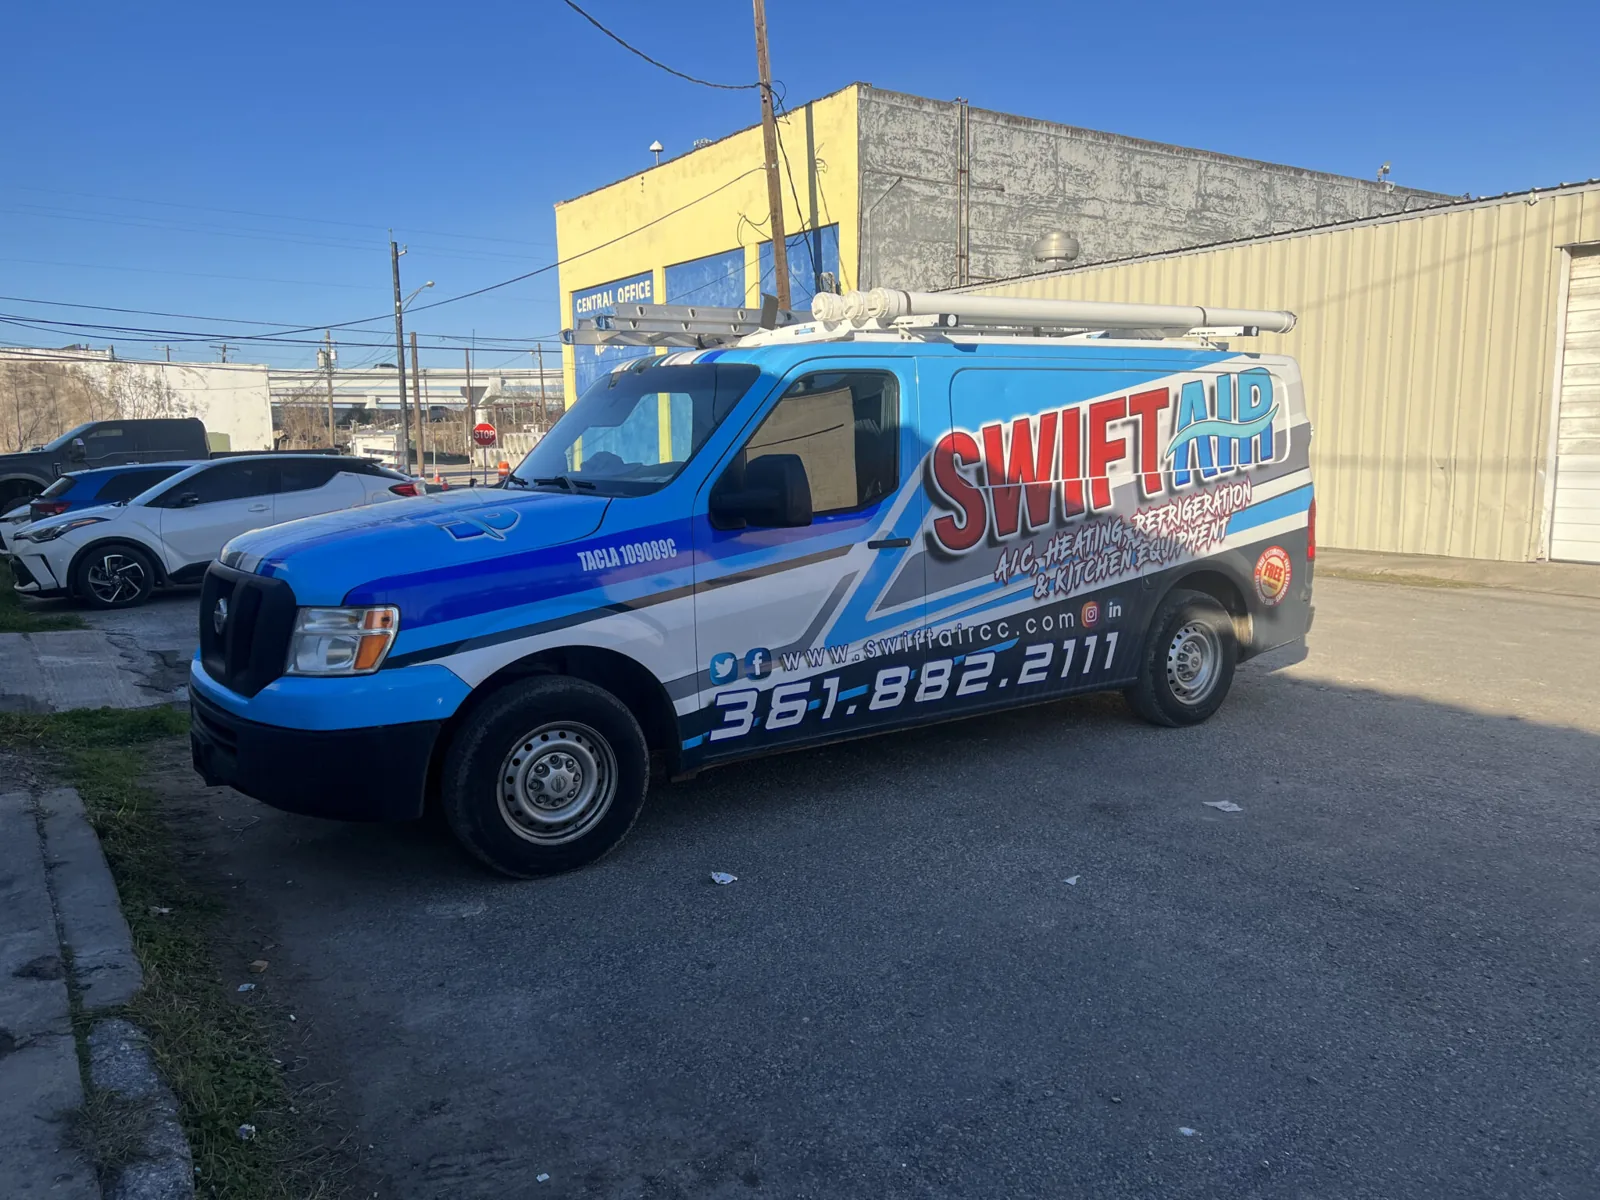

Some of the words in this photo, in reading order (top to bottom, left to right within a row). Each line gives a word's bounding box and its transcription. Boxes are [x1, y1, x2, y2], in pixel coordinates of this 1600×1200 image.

[576, 290, 614, 313] CENTRAL
[617, 280, 651, 304] OFFICE
[474, 429, 495, 439] STOP
[932, 386, 1170, 552] SWIFT
[1168, 366, 1279, 487] AIR
[1132, 478, 1252, 534] REFRIGERATION
[577, 547, 621, 571] TACLA
[619, 538, 677, 565] 109089C
[1034, 574, 1049, 599] &
[1054, 550, 1136, 593] KITCHEN
[1134, 517, 1231, 568] EQUIPMENT
[781, 610, 1075, 672] www.swiftaircc.com
[709, 631, 1119, 742] 361.882.2111
